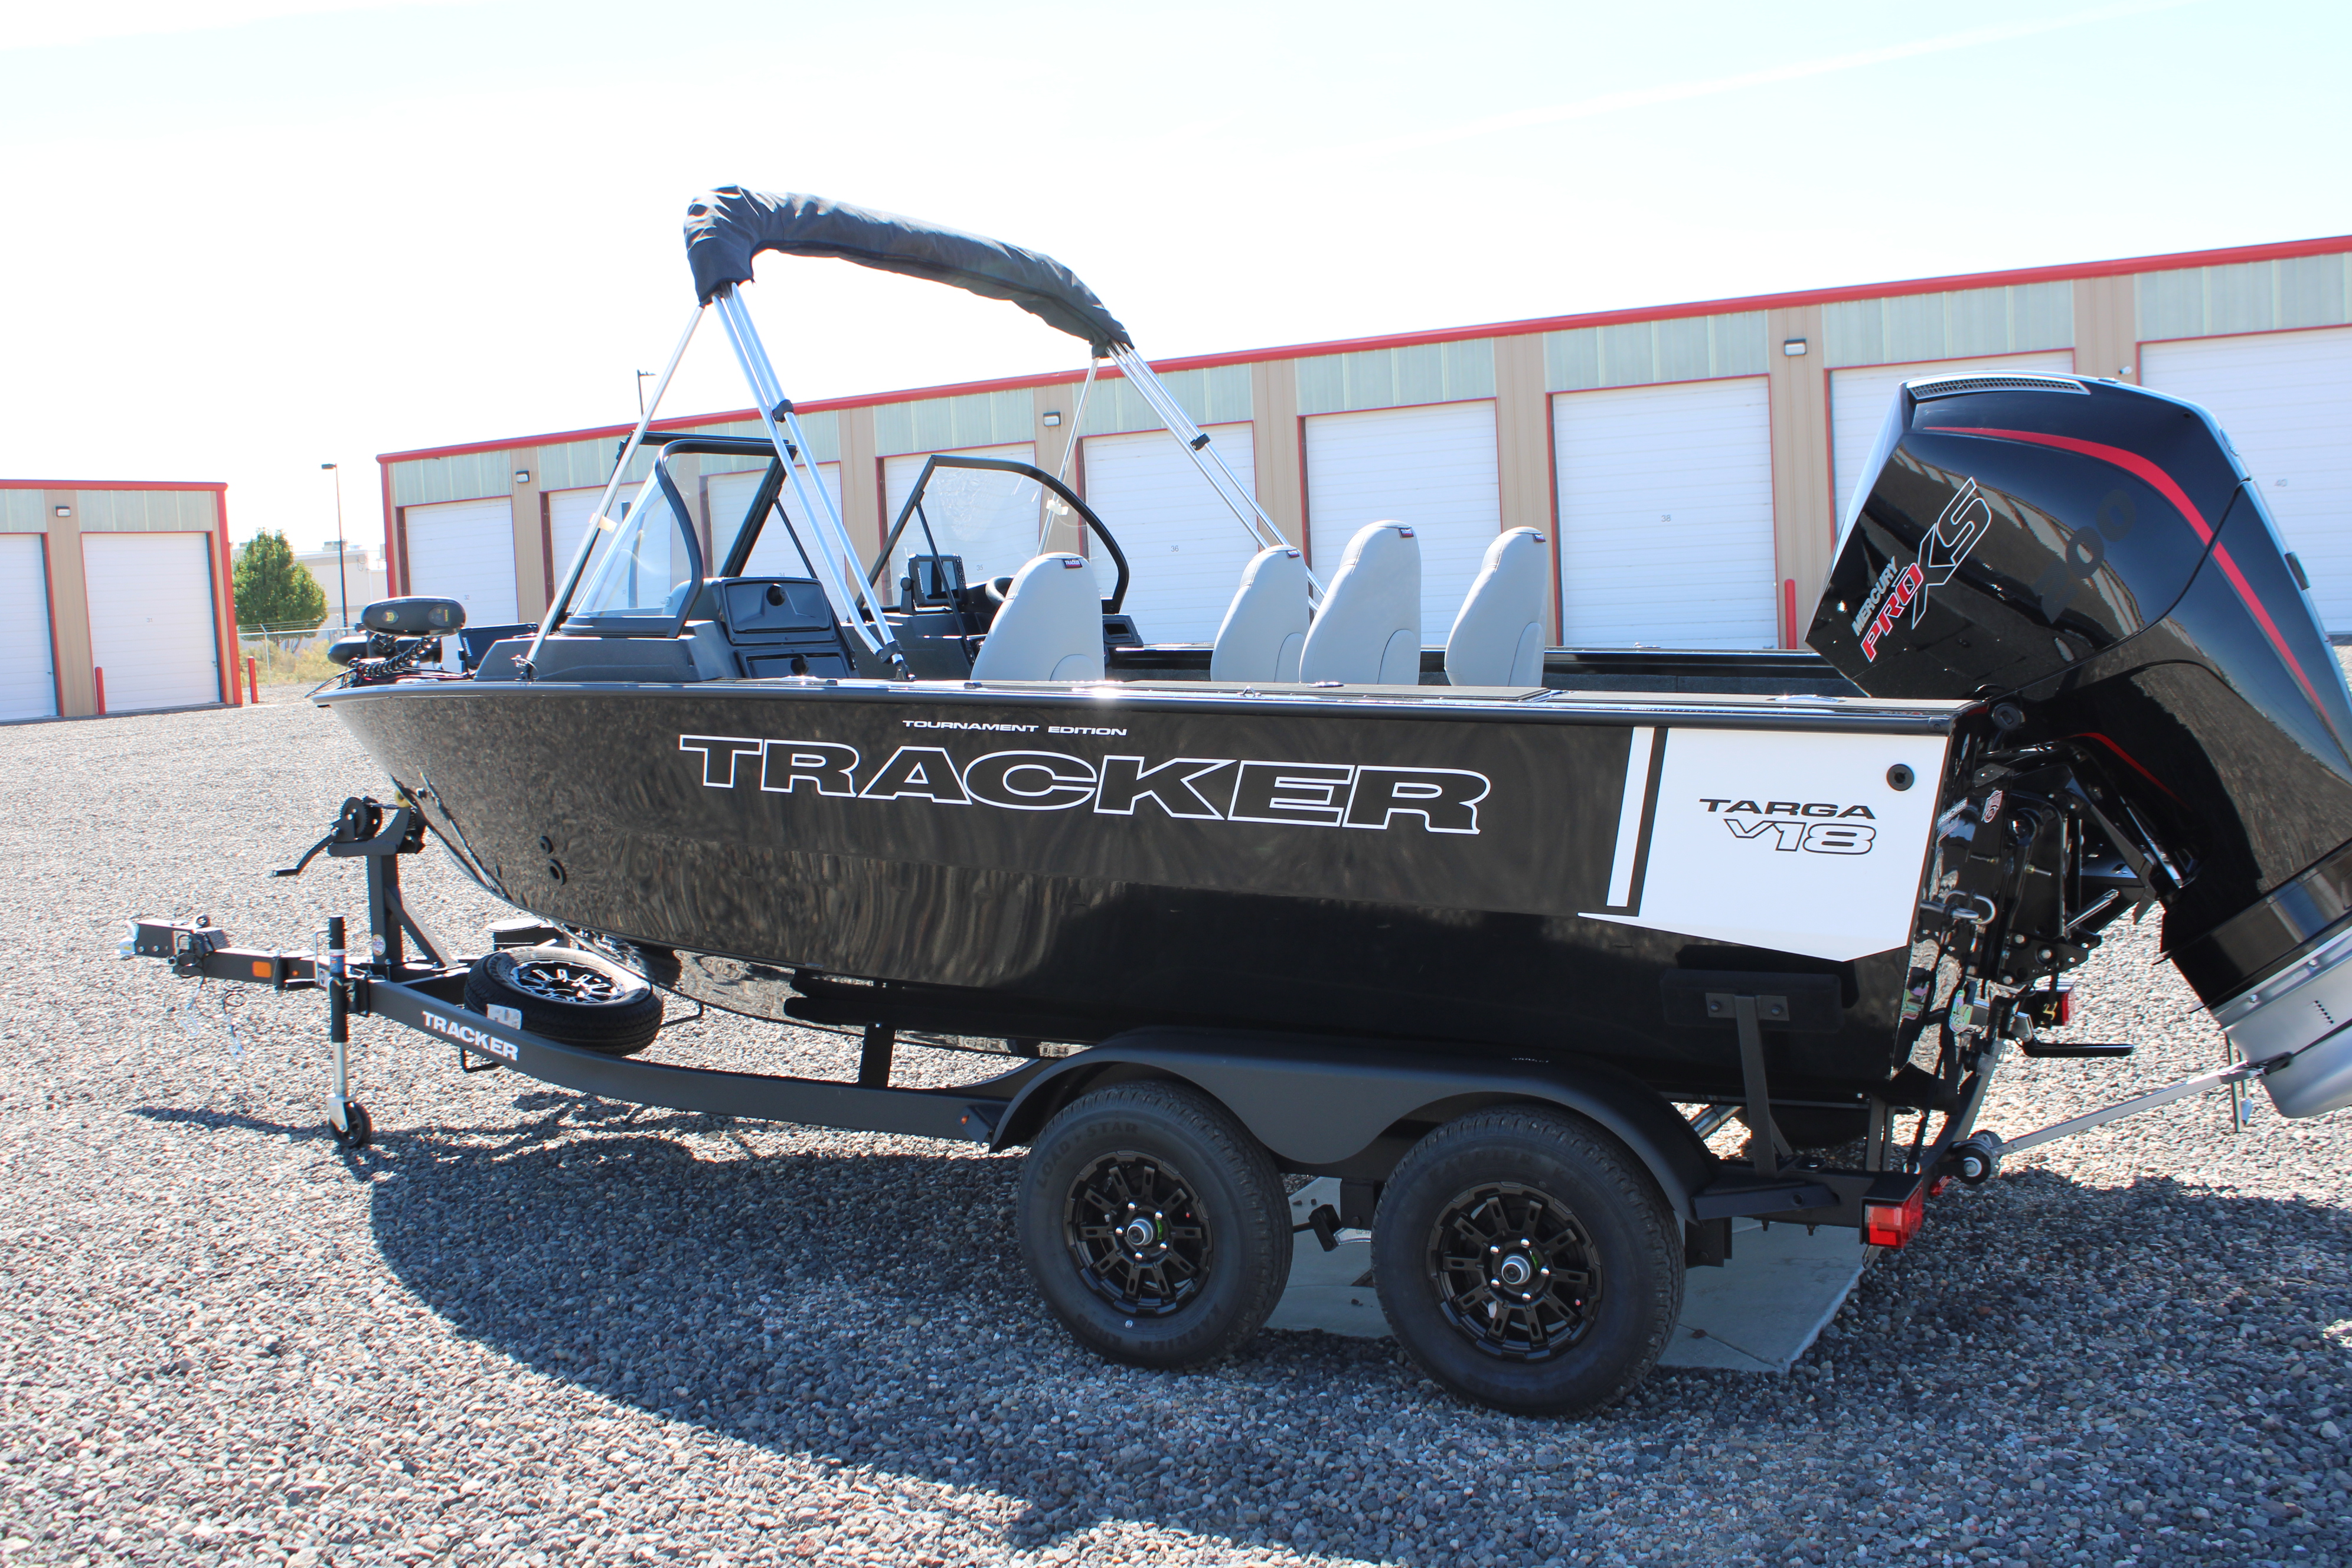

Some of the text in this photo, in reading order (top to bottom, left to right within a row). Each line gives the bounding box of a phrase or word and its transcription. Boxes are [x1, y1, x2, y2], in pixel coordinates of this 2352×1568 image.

[1860, 476, 1992, 662] PRO XS
[2031, 489, 2136, 625] 200
[1851, 556, 1899, 636] MERCURY
[902, 720, 1127, 736] TOURNAMENT EDITION
[679, 734, 1491, 835] TRACKER
[1698, 798, 1877, 820] TARGA
[1937, 797, 1968, 828] TRACKER
[1723, 818, 1877, 855] V18
[422, 1010, 519, 1061] TRACKER
[1035, 1121, 1140, 1189] LOAD STAR
